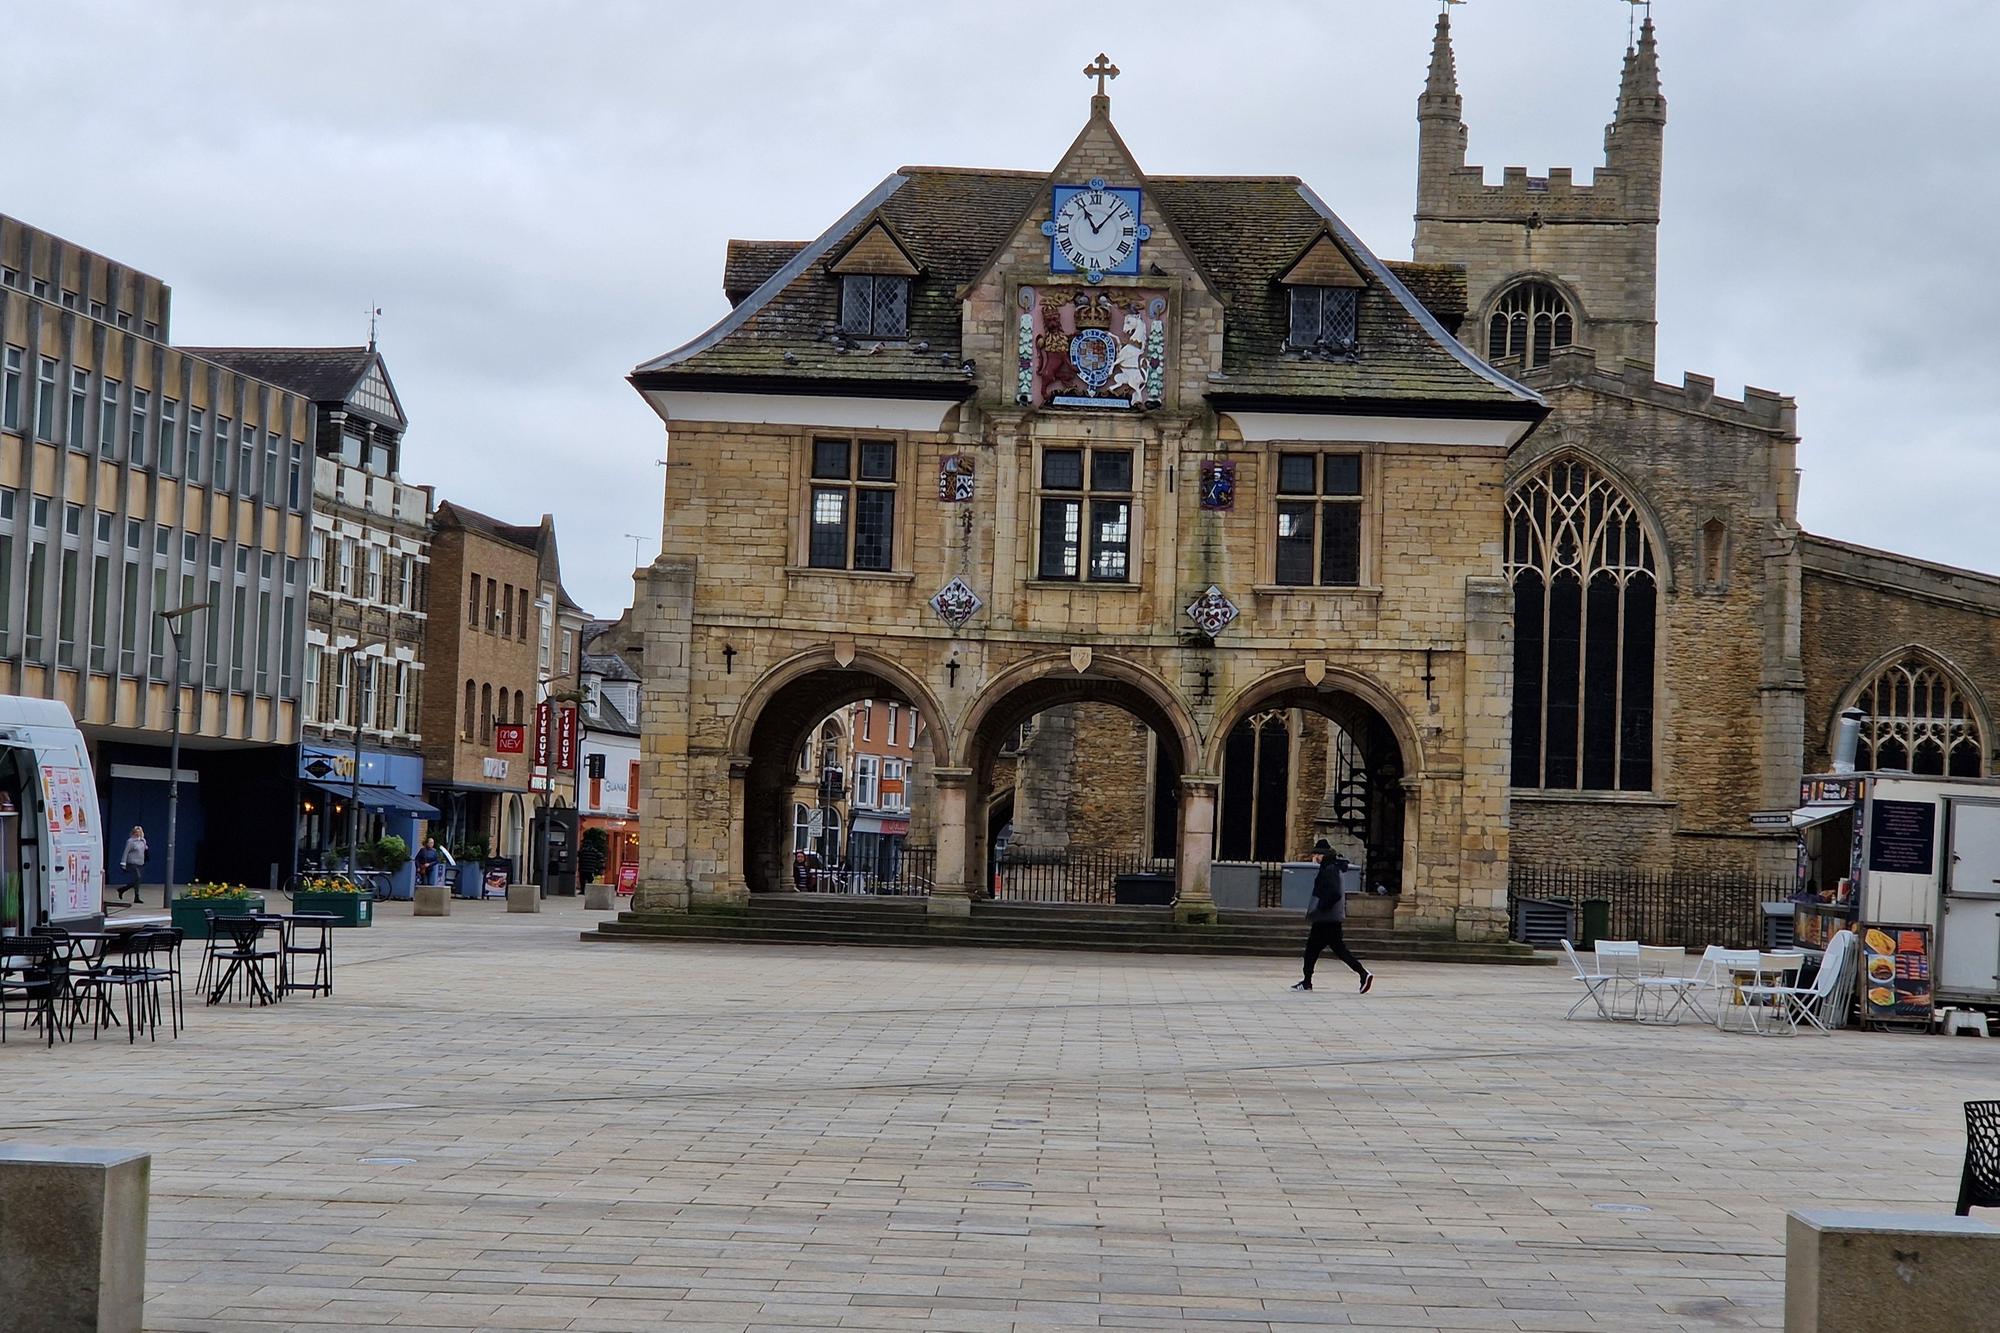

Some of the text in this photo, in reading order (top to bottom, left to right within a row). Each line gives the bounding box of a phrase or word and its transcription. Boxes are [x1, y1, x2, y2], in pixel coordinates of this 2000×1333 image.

[1089, 194, 1102, 205] XII
[1119, 211, 1130, 221] II
[1123, 227, 1133, 236] III
